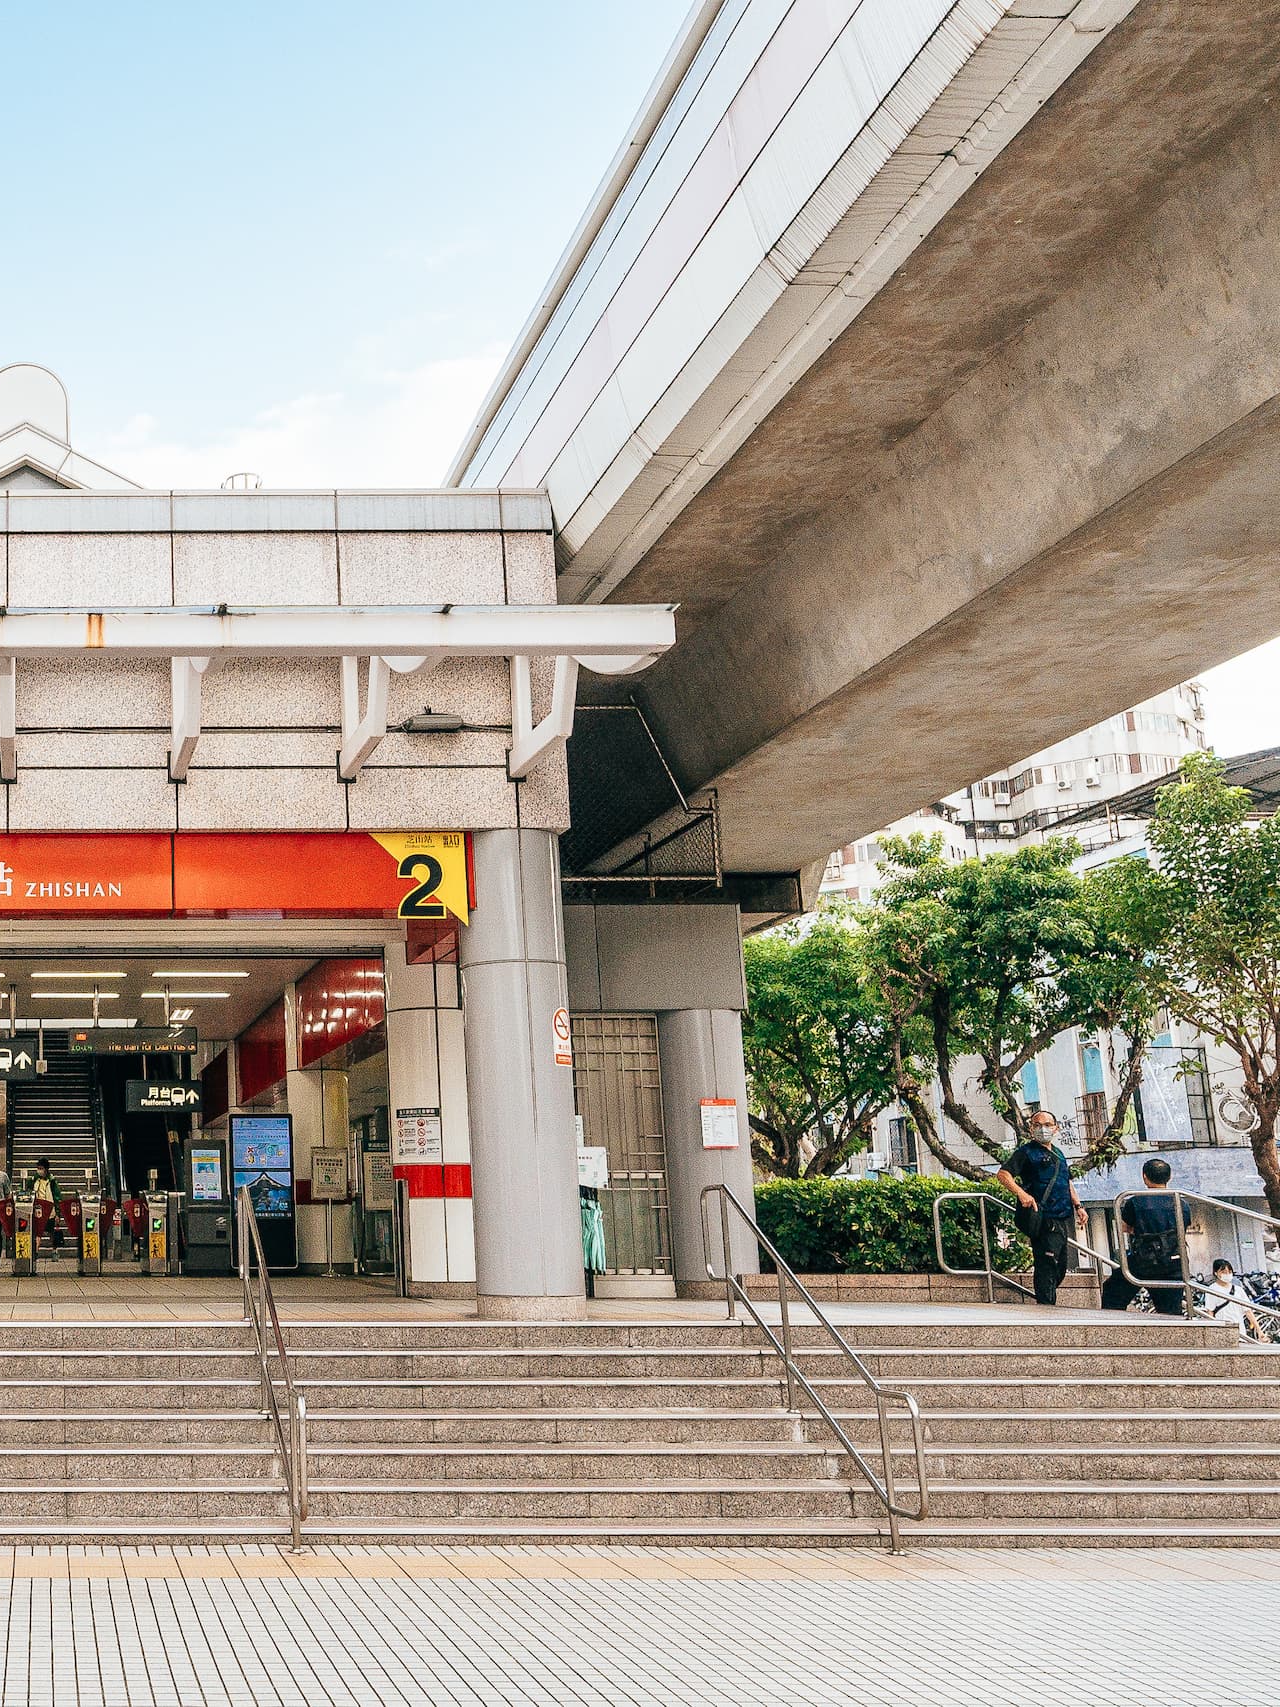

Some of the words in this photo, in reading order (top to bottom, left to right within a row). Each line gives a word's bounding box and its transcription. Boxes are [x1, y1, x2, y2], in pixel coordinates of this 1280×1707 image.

[25, 882, 122, 897] ZHISHAN
[399, 853, 445, 918] 2
[148, 1087, 171, 1099] 月台
